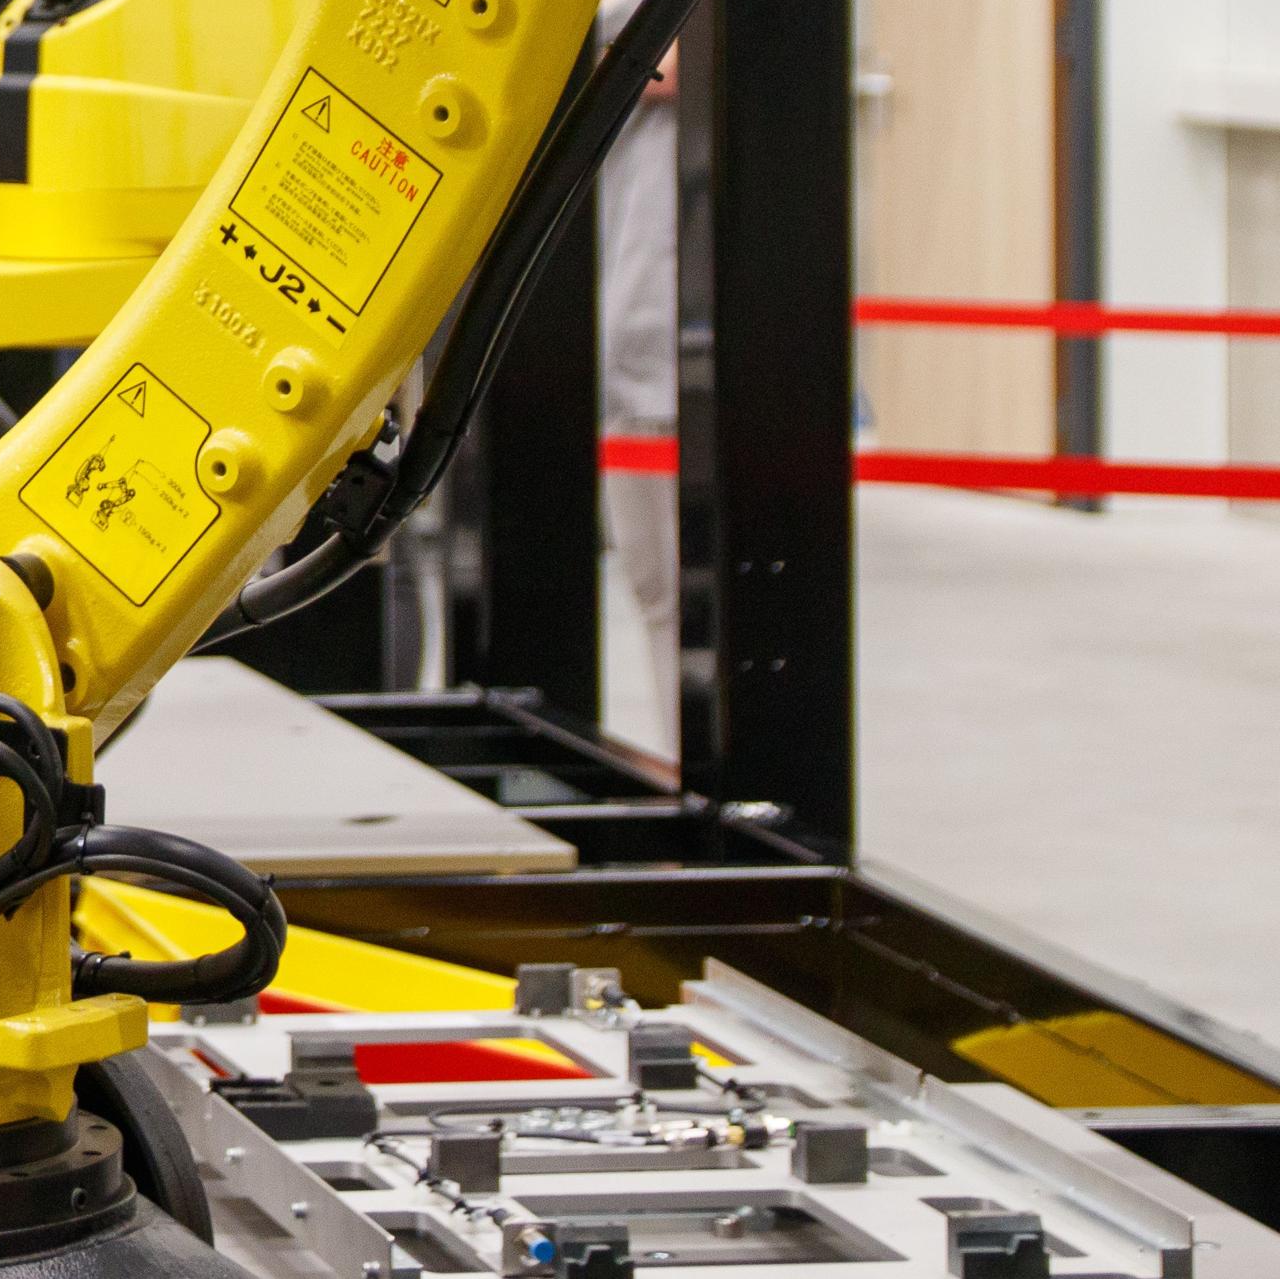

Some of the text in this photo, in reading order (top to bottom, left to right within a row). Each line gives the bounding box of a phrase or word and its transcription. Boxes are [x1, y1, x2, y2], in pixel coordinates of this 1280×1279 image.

[351, 140, 419, 202] CAUTION
[376, 137, 409, 171] 注意
[259, 263, 306, 305] J2
